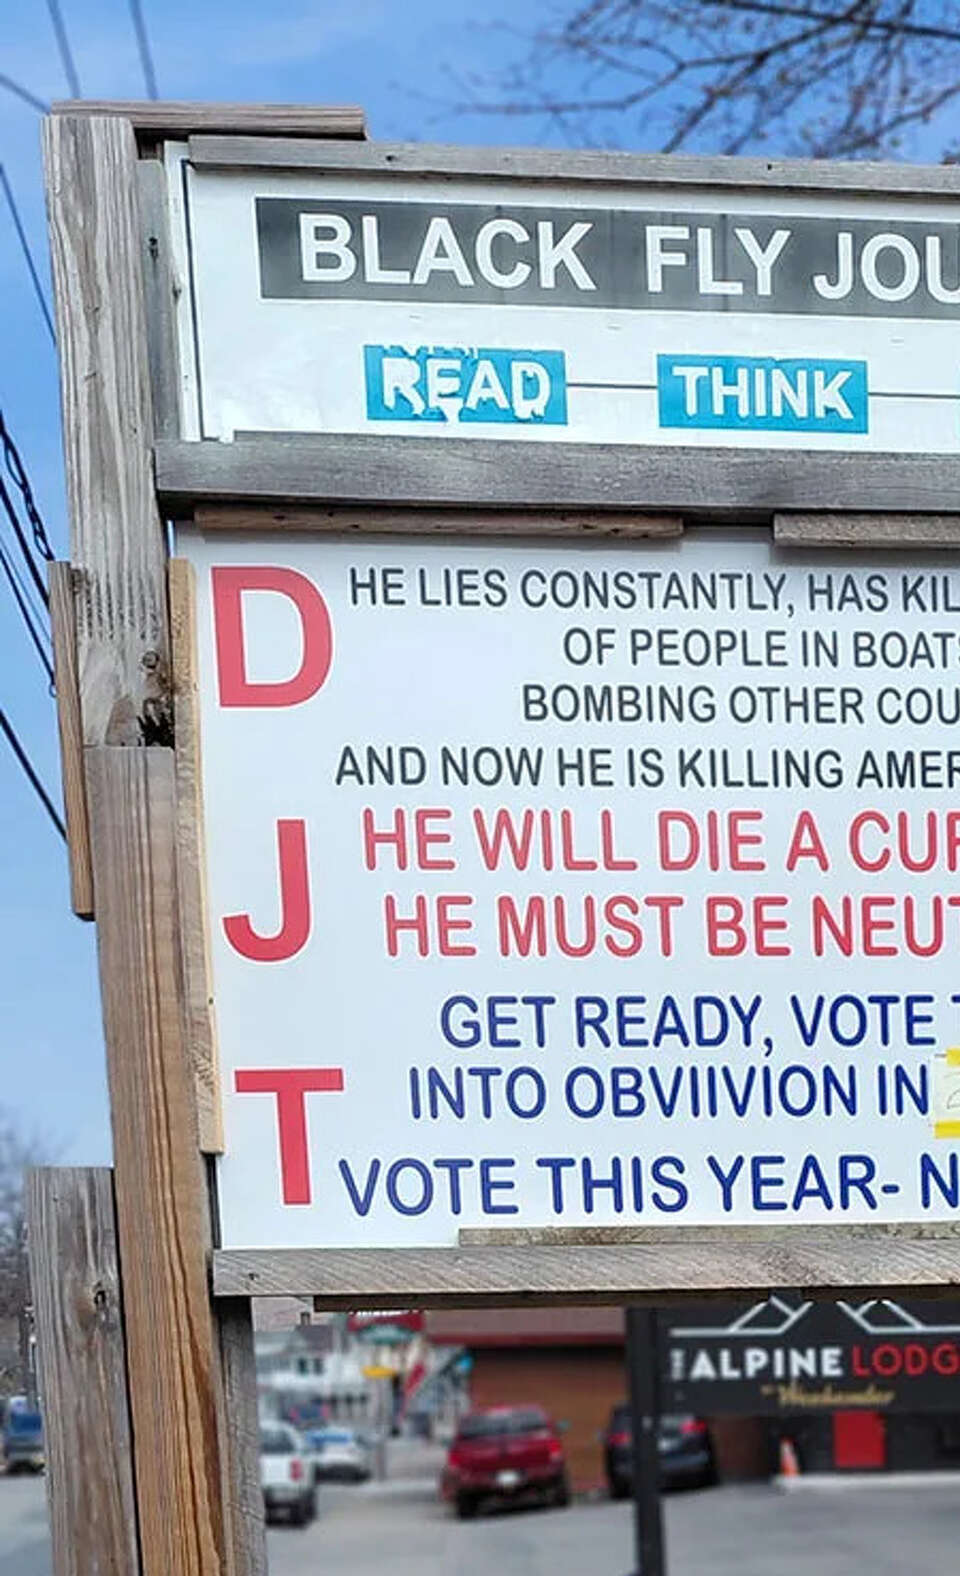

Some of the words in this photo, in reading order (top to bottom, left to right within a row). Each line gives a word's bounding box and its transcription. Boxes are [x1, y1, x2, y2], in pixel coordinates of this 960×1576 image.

[299, 212, 597, 291] BLACK
[646, 226, 791, 296] FLY
[382, 358, 551, 421] READ
[673, 366, 853, 423] THINK
[350, 567, 405, 606] HE
[419, 567, 508, 608] LIES
[520, 568, 795, 616] CONSTANTLY,
[808, 574, 889, 612] HAS
[212, 566, 331, 709] D
[563, 627, 615, 665] OF
[630, 628, 788, 666] PEOPLE
[801, 630, 838, 667] IN
[523, 684, 716, 722] BOMBING
[729, 686, 864, 723] OTHER
[335, 746, 426, 785] AND
[441, 746, 543, 786] NOW
[557, 747, 614, 786] HE
[627, 747, 664, 787] IS
[678, 748, 843, 788] KILLING
[363, 808, 455, 869] HE
[473, 809, 637, 870] WILL
[658, 810, 765, 870] DIE
[786, 811, 829, 871] A
[222, 818, 313, 963] J
[385, 895, 476, 956] HE
[498, 895, 683, 956] MUST
[706, 896, 790, 956] BE
[440, 995, 556, 1048] GET
[575, 995, 773, 1054] READY,
[790, 994, 936, 1046] VOTE
[409, 1066, 546, 1119] INTO
[565, 1065, 857, 1117] OBVIIVION
[877, 1064, 928, 1115] IN
[234, 1068, 344, 1208] T
[338, 1158, 519, 1215] VOTE
[535, 1156, 688, 1213] THIS
[706, 1154, 900, 1210] YEAR-
[691, 1347, 843, 1380] ALPINE
